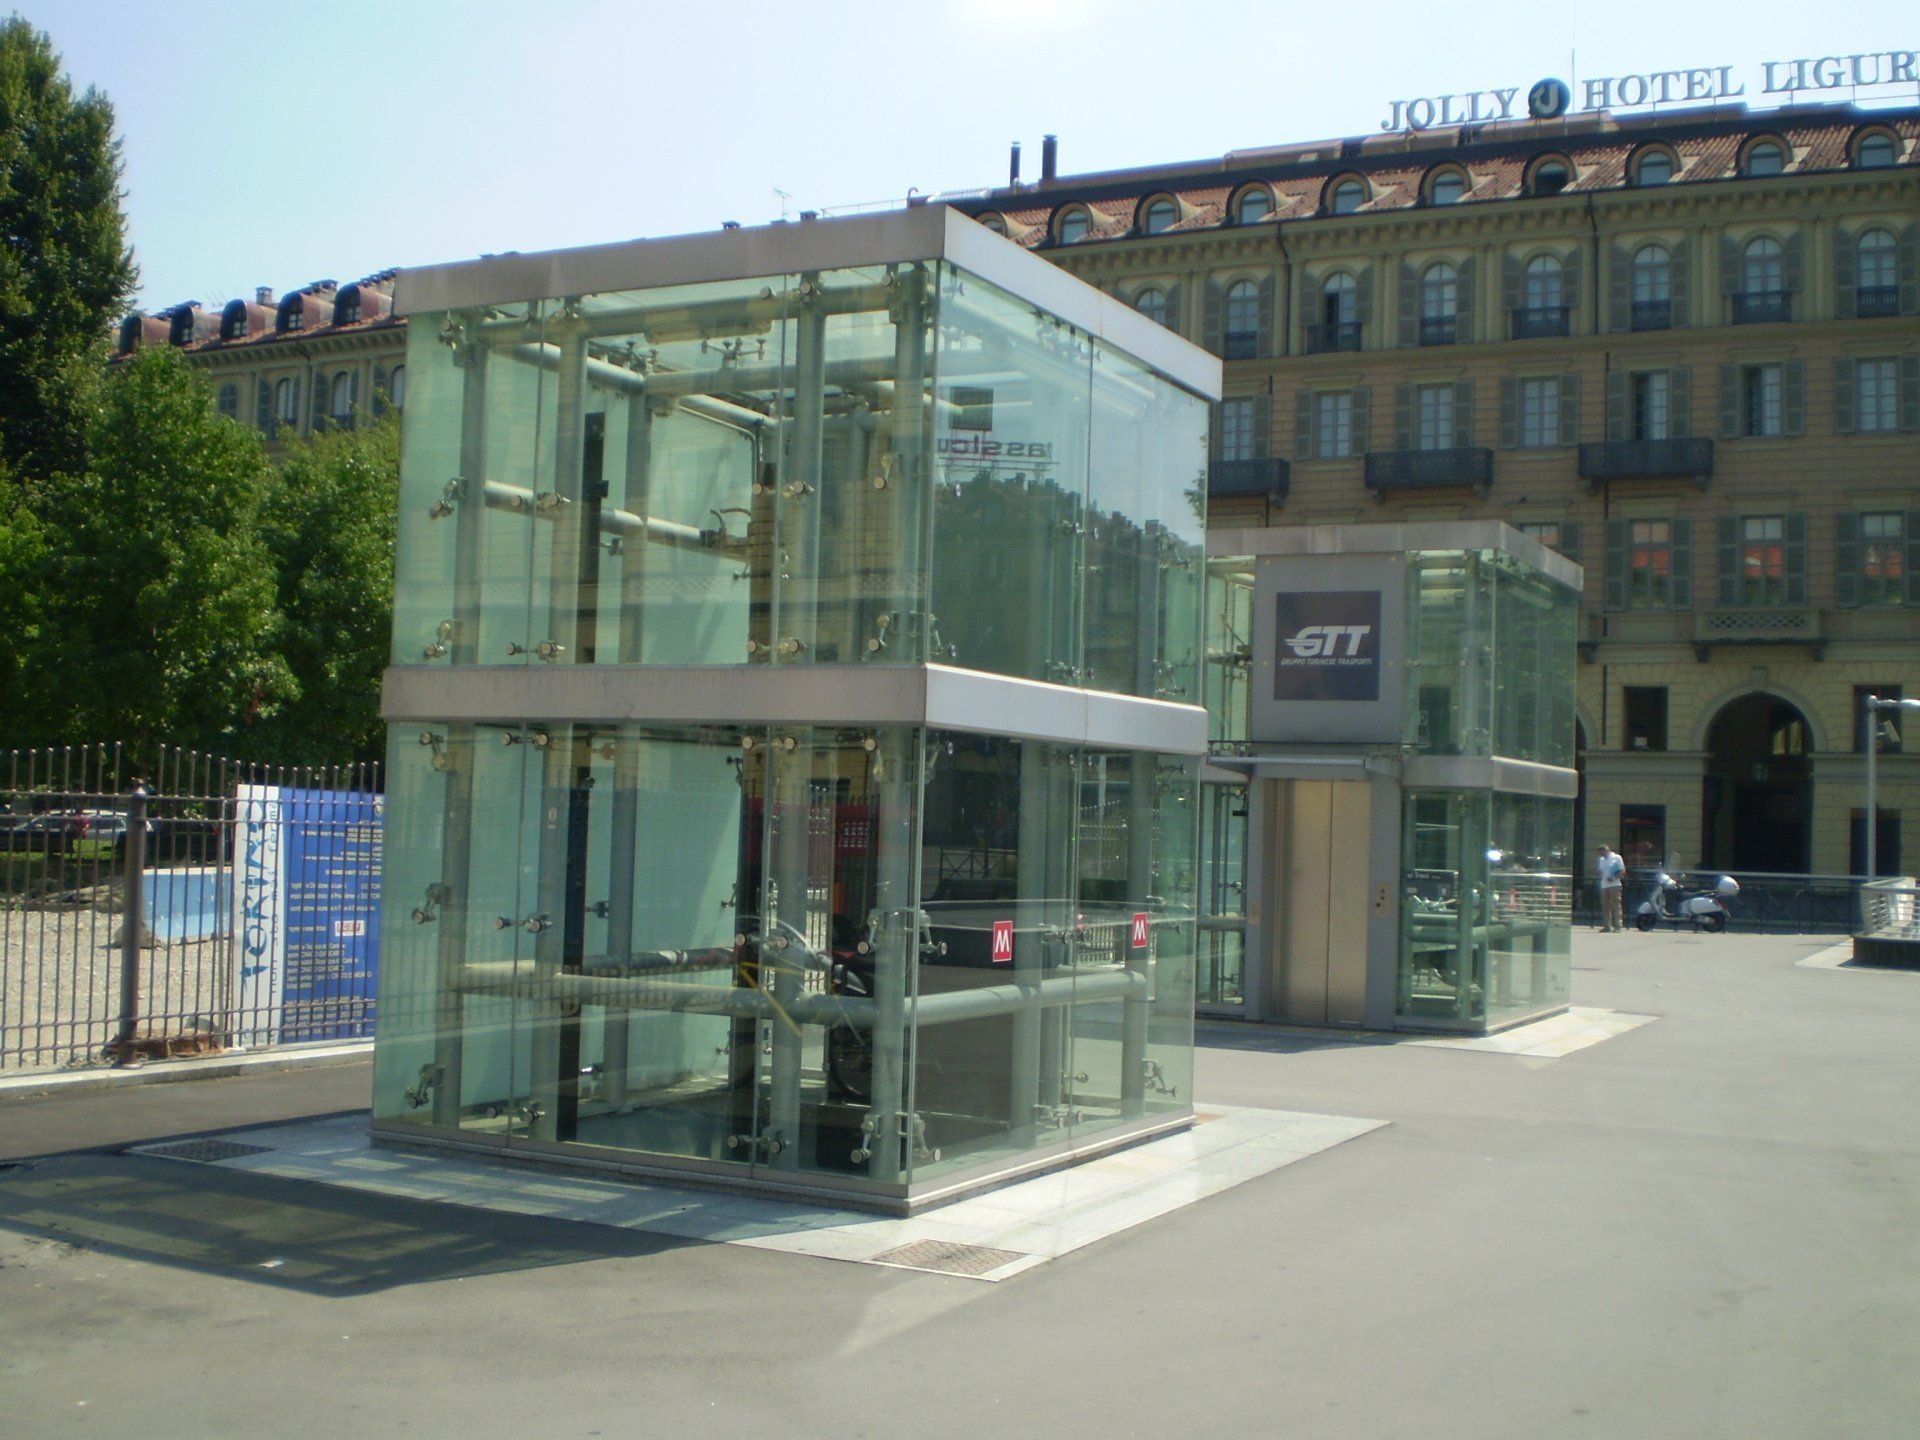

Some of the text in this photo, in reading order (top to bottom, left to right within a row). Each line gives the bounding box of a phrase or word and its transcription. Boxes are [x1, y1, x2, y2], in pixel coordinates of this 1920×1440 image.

[1381, 87, 1520, 131] JOLLY
[1582, 66, 1746, 111] HOTEL
[1761, 50, 1919, 94] LIGUR
[1284, 625, 1371, 657] GTT
[238, 798, 270, 988] TORINO
[994, 930, 1010, 952] M
[1133, 920, 1147, 942] M
